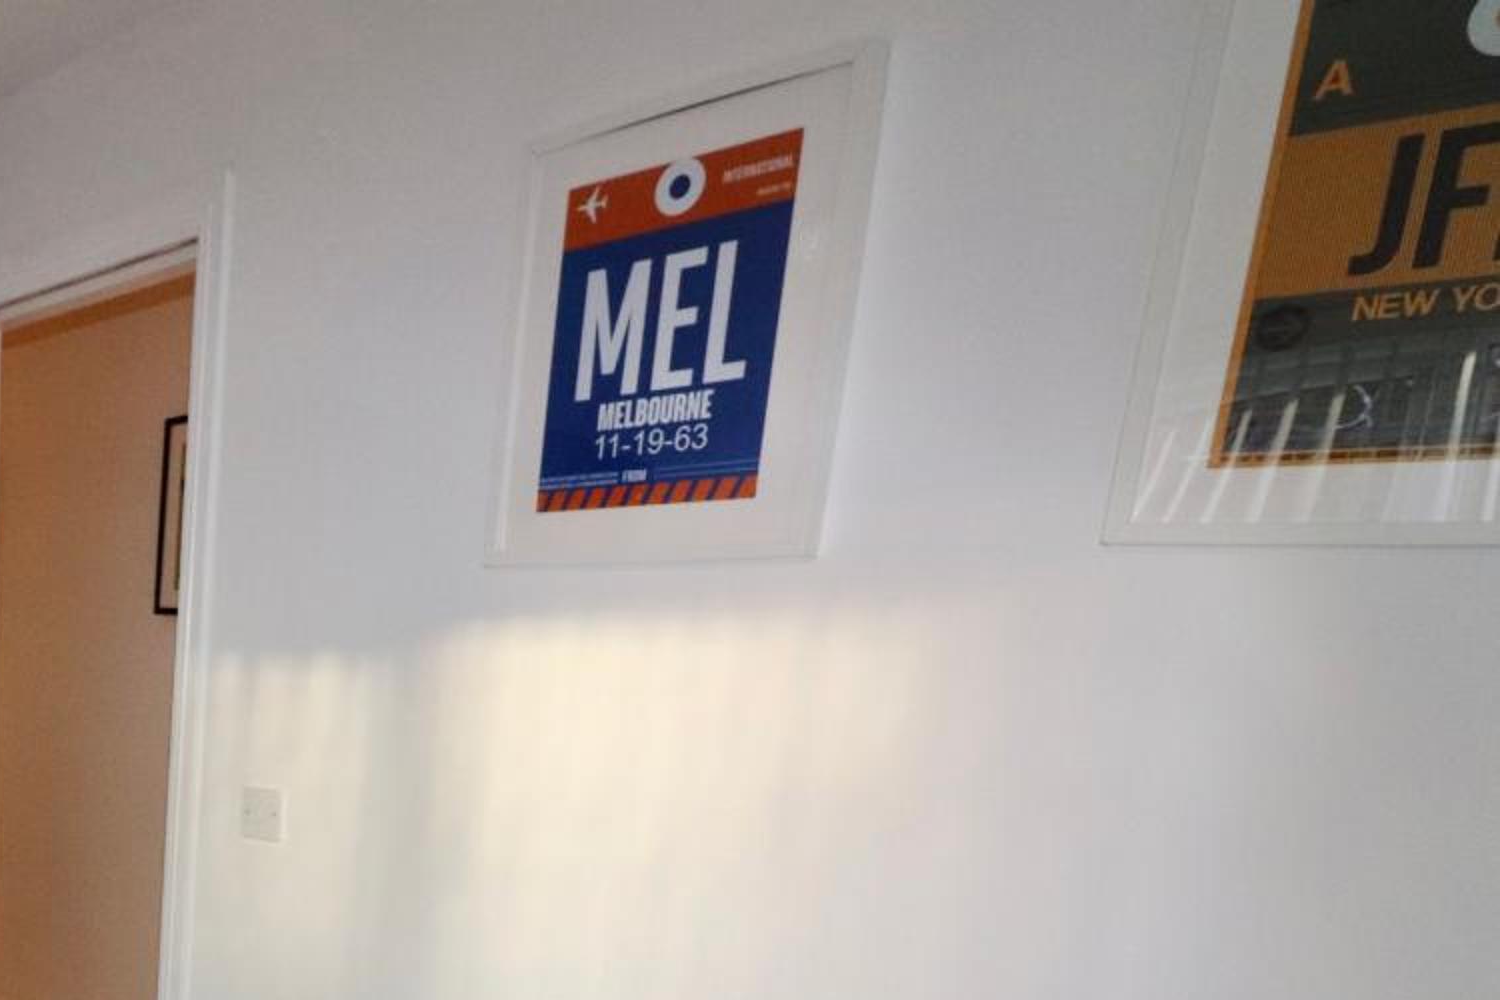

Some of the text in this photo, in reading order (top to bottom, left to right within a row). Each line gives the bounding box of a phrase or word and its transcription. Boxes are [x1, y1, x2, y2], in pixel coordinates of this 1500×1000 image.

[1315, 60, 1353, 98] A
[1348, 121, 1500, 275] JF
[574, 239, 747, 402] MEL
[1351, 288, 1440, 320] NEW
[597, 389, 714, 431] MELBOURNE
[594, 423, 708, 460] 11-19-63
